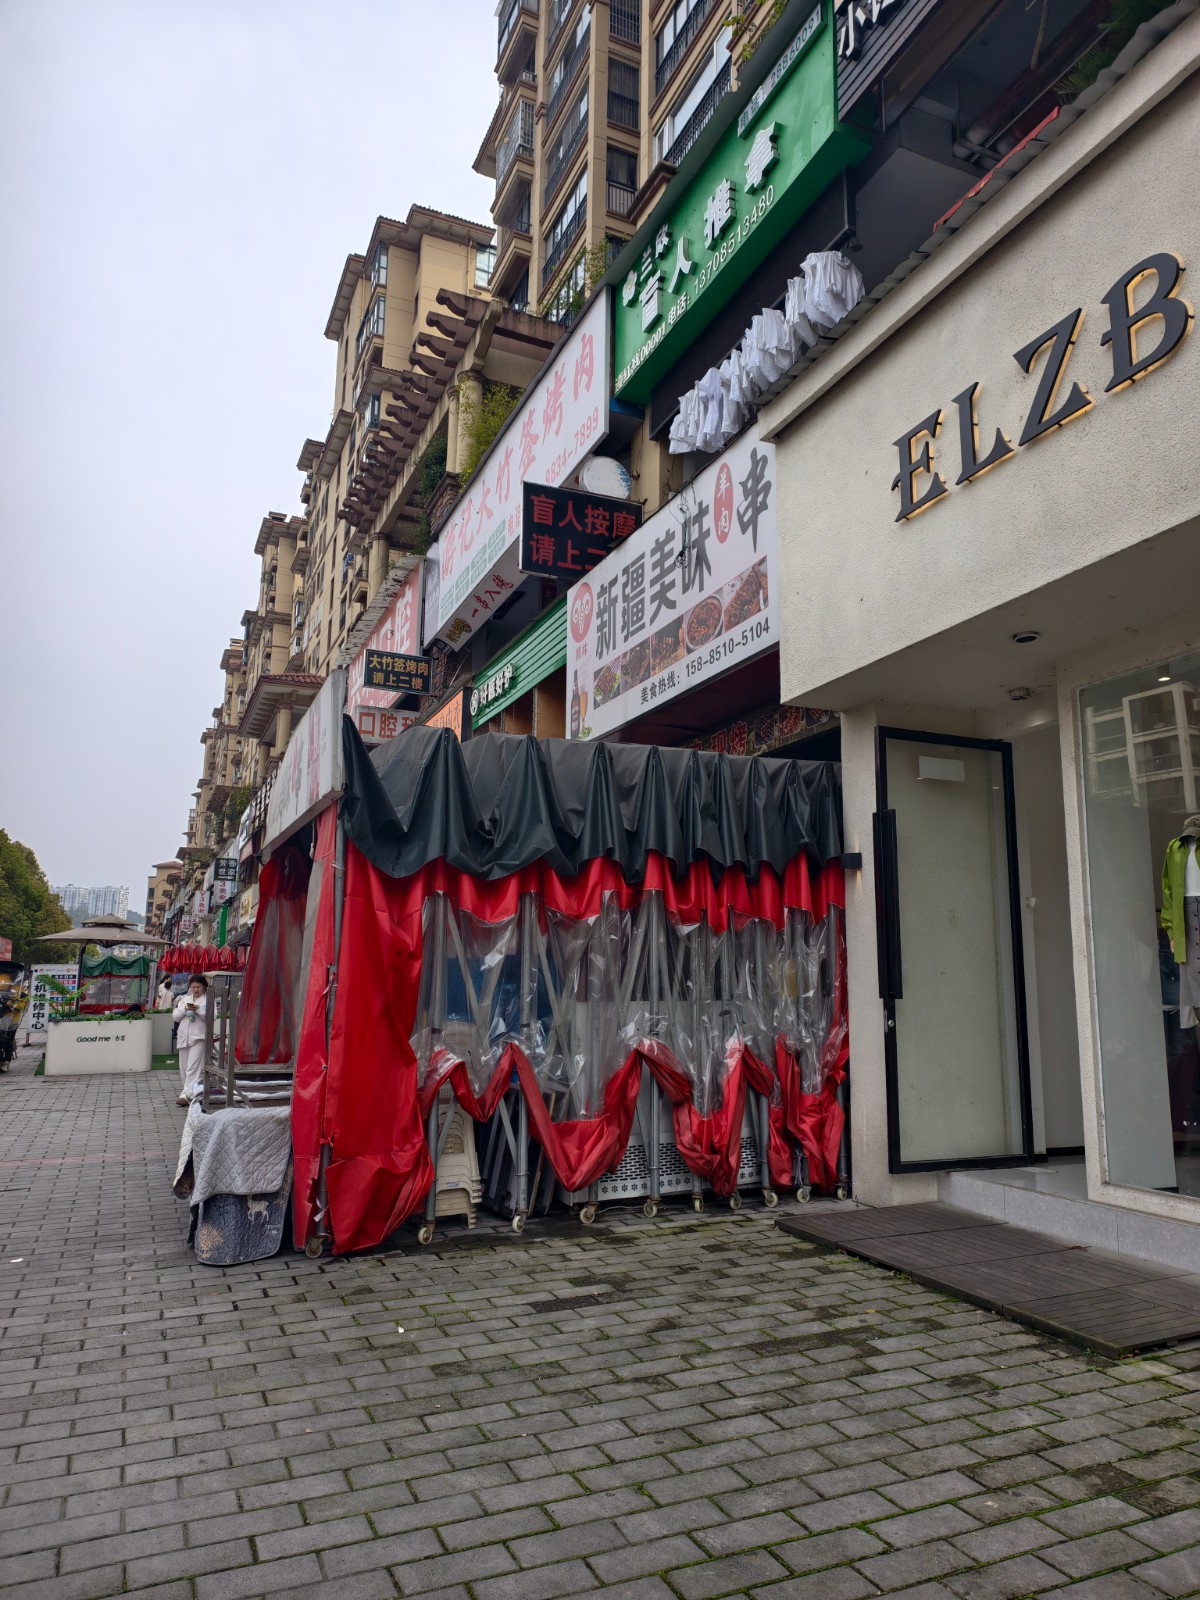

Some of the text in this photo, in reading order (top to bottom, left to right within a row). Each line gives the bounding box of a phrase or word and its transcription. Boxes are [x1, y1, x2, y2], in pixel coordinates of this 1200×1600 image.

[692, 184, 775, 296] 13708513480
[891, 253, 1191, 522] ELZB
[530, 494, 636, 538] 盲人按摩
[369, 654, 429, 677] 大竹签烤肉
[685, 616, 770, 678] 158-8510-5104
[371, 671, 424, 691] 请上二楼
[31, 978, 48, 1030] 机维修中心
